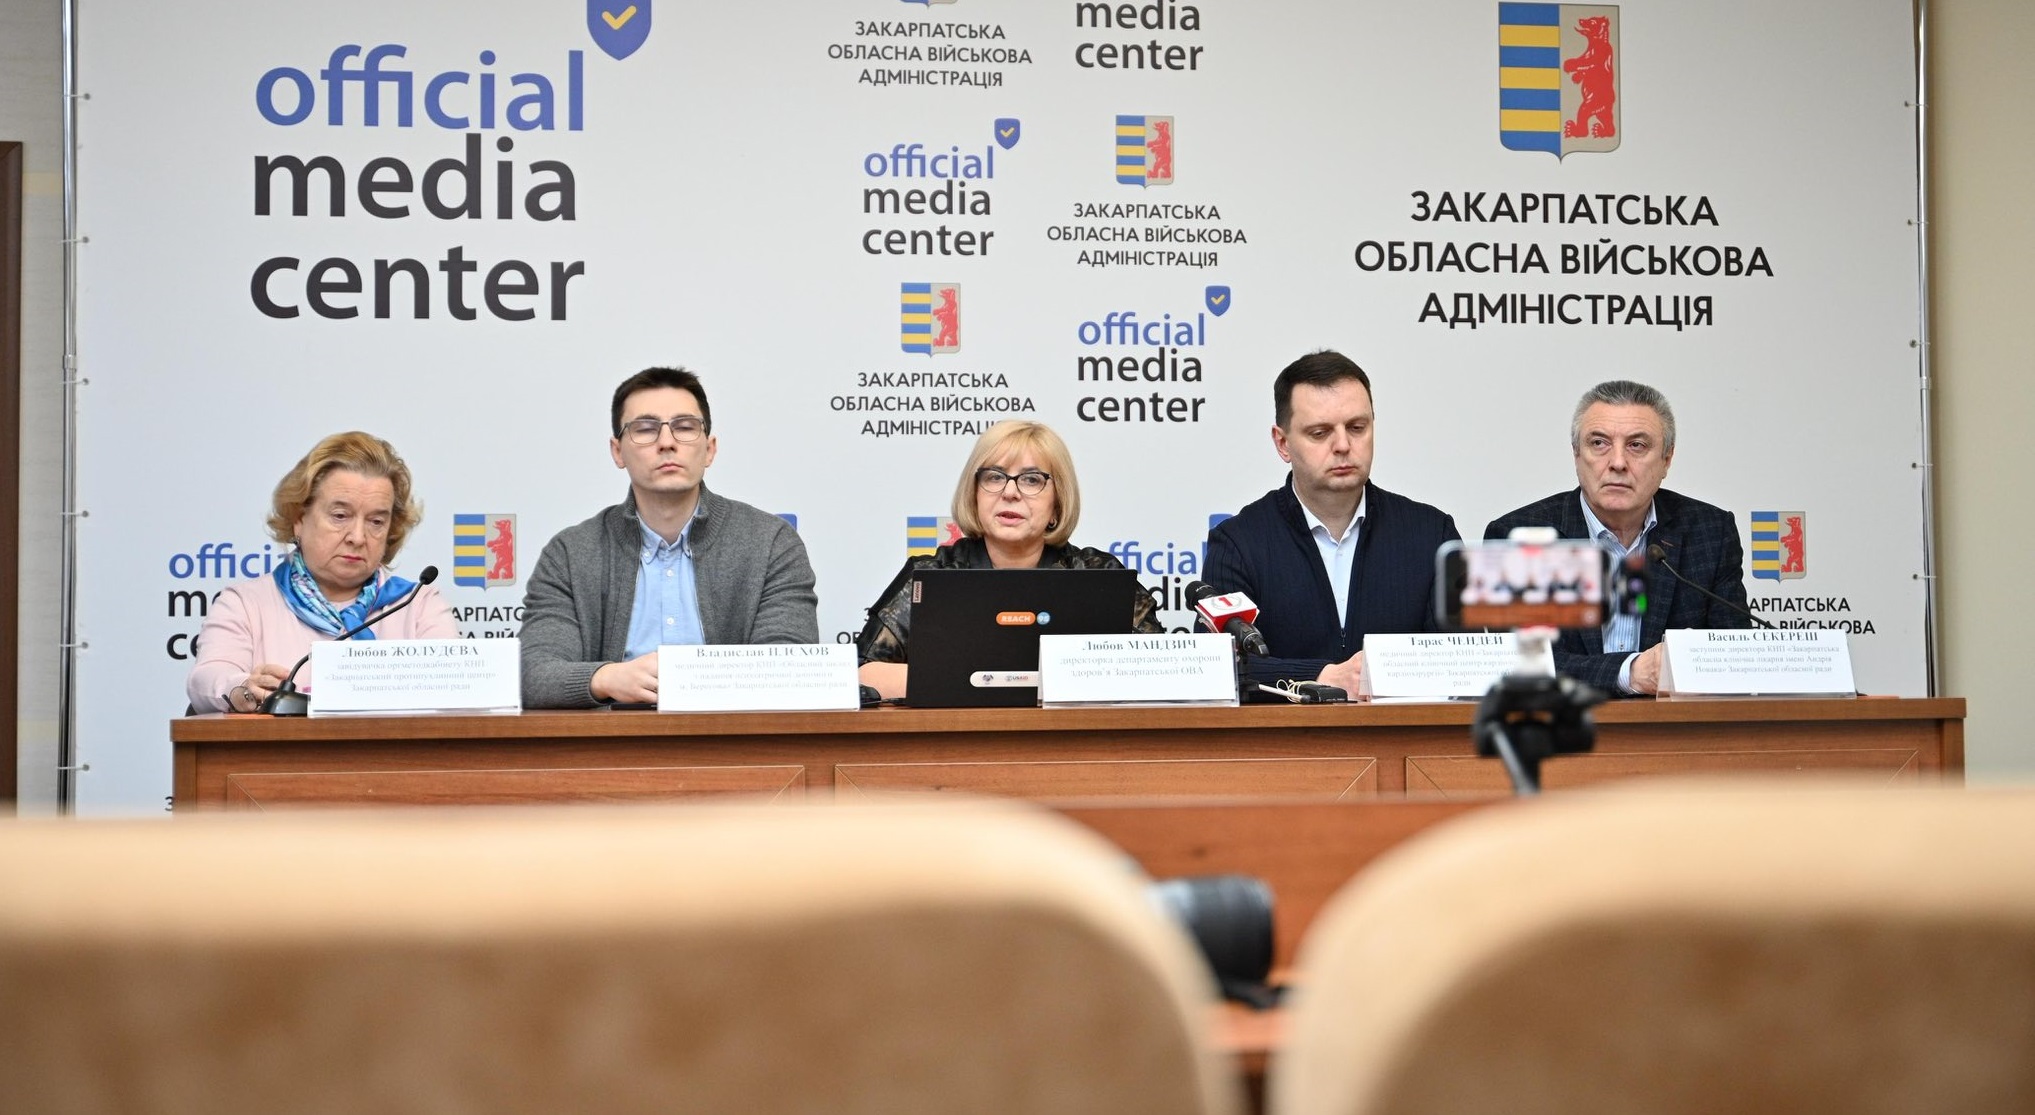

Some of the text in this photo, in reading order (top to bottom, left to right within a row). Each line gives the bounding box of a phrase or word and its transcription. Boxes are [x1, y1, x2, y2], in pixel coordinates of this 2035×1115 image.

[1075, 0, 1201, 31] media
[855, 21, 1006, 40] ЗАКАРПАТСЬКА
[827, 44, 1033, 65] ОБЛАСНА ВІЙСЬКОВА
[1075, 39, 1204, 71] center
[255, 43, 584, 132] official
[858, 69, 1003, 89] АДМІНІСТРАЦІЯ
[863, 143, 994, 179] official
[254, 132, 577, 222] media
[863, 179, 991, 216] media
[1073, 203, 1221, 221] ЗАКАРПАТСЬКА
[1410, 190, 1720, 227] ЗАКАРПАТСЬКА
[862, 224, 995, 257] center
[1046, 224, 1248, 245] ОБЛАСНА ВІЙСЬКОВА
[1076, 249, 1218, 270] АДМІНІСТРАЦІЯ
[1354, 237, 1775, 278] ОБЛАСНА ВІЙСЬКОВА
[250, 245, 585, 322] center
[1417, 292, 1713, 332] АДМІНІСТРАЦІЯ
[1078, 311, 1205, 346] official
[1077, 346, 1203, 383] media
[857, 371, 1009, 389] ЗАКАРПАТСЬКА
[830, 393, 1036, 413] ОБЛАСНА ВІЙСЬКОВА
[1076, 391, 1206, 423] center
[860, 419, 995, 438] АДМІНІСТРАЦ
[168, 542, 288, 579] offici
[1749, 597, 1851, 612] АРПАТСЬКА
[1082, 639, 1197, 651] Любов МАНДЗИЧ
[1408, 633, 1504, 648] Тарас ЧЕНДЕЙ
[1707, 631, 1819, 642] Василь СЕКЕРЕШ
[341, 646, 387, 658] Любов
[696, 647, 765, 658] Владислав
[1180, 666, 1204, 675] ОВА
